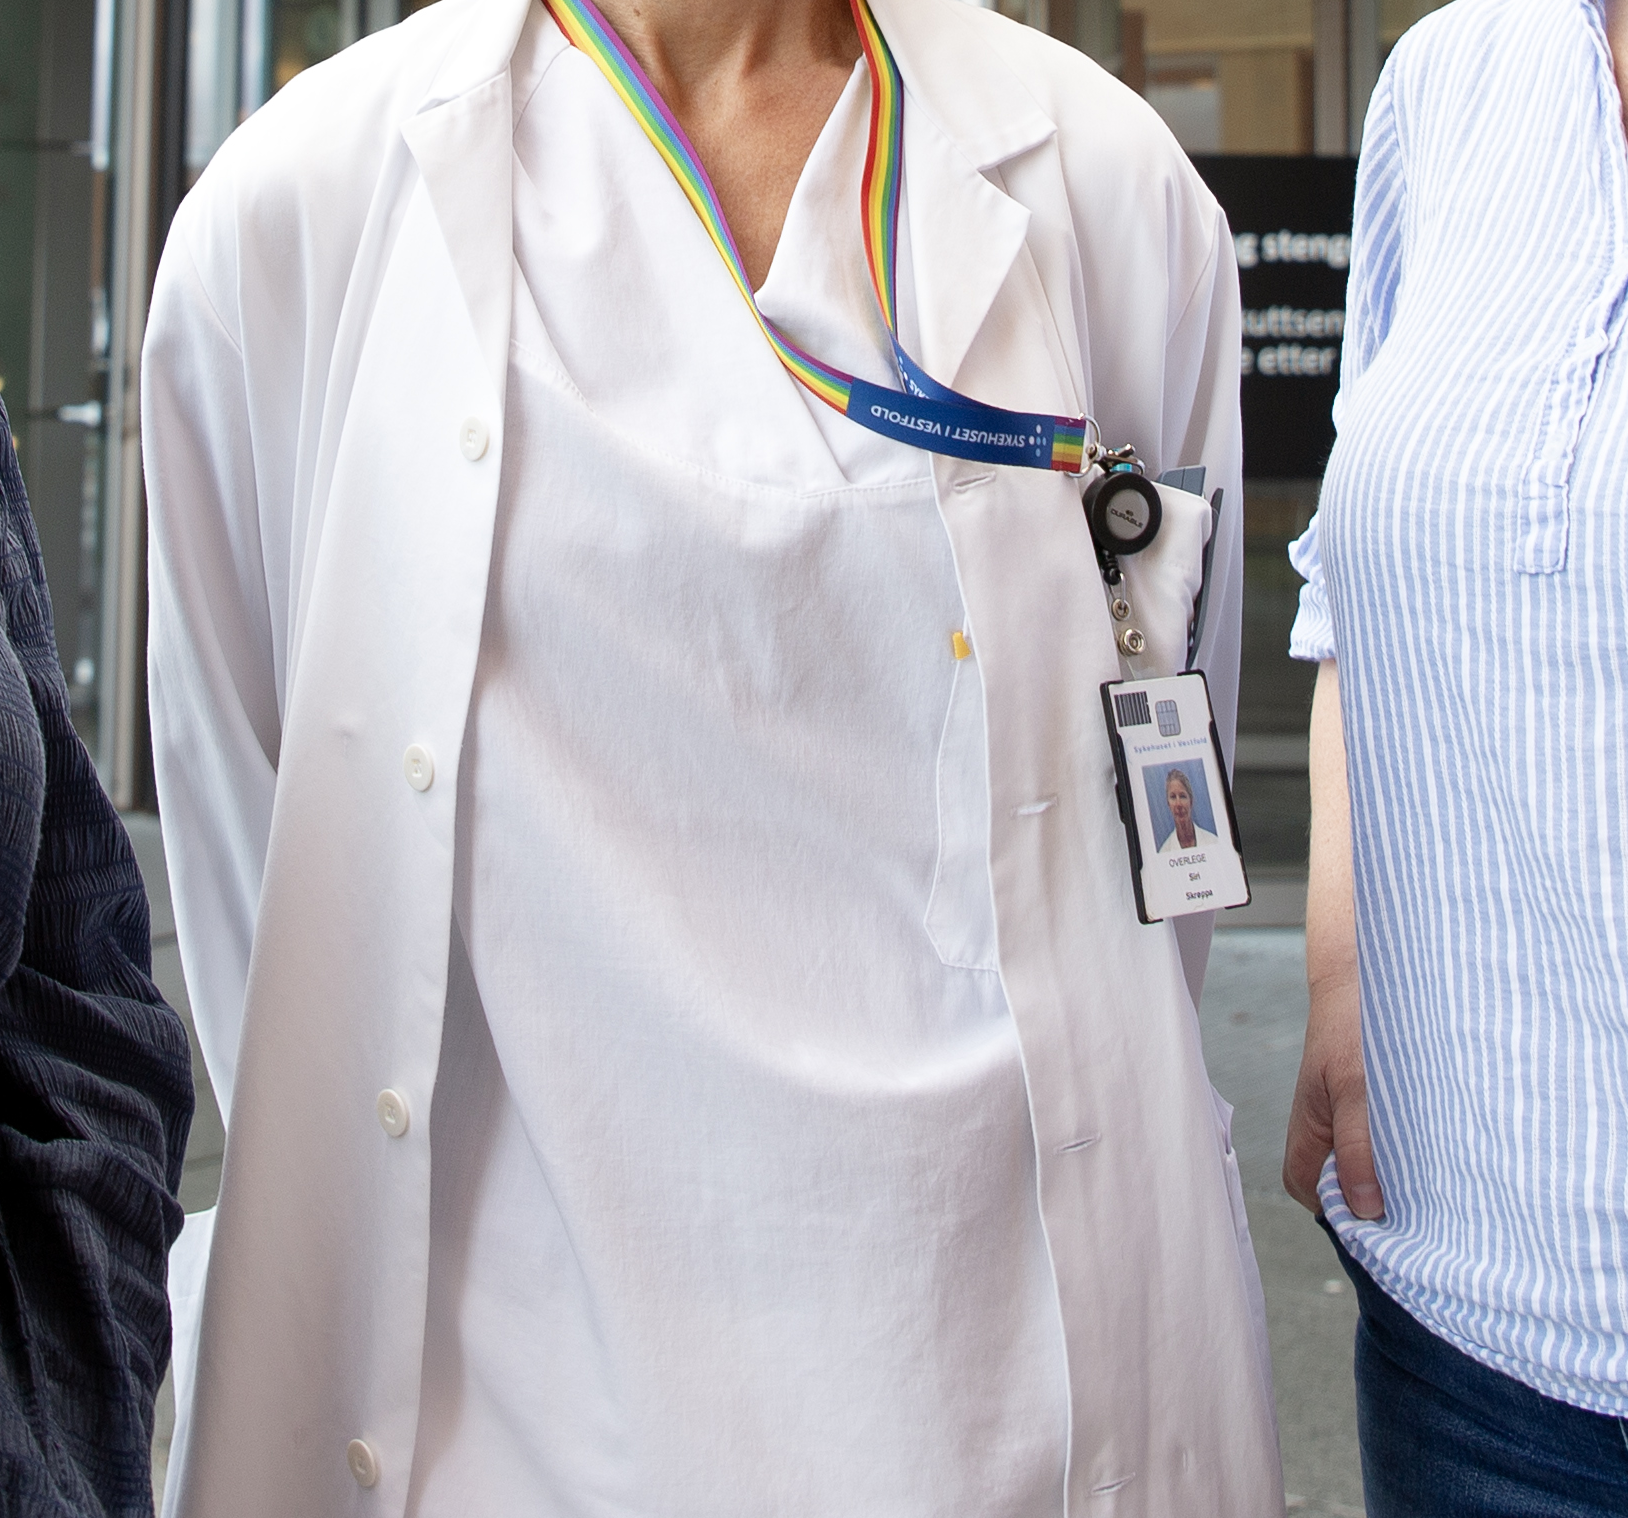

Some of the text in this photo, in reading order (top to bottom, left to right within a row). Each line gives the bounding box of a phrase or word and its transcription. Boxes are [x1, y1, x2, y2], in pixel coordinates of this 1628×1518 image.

[1241, 305, 1345, 338] uttsen
[1257, 342, 1337, 377] etter
[870, 405, 1026, 447] SYKEHUSET I VESTFOLD
[1168, 853, 1206, 868] OVERLEGE
